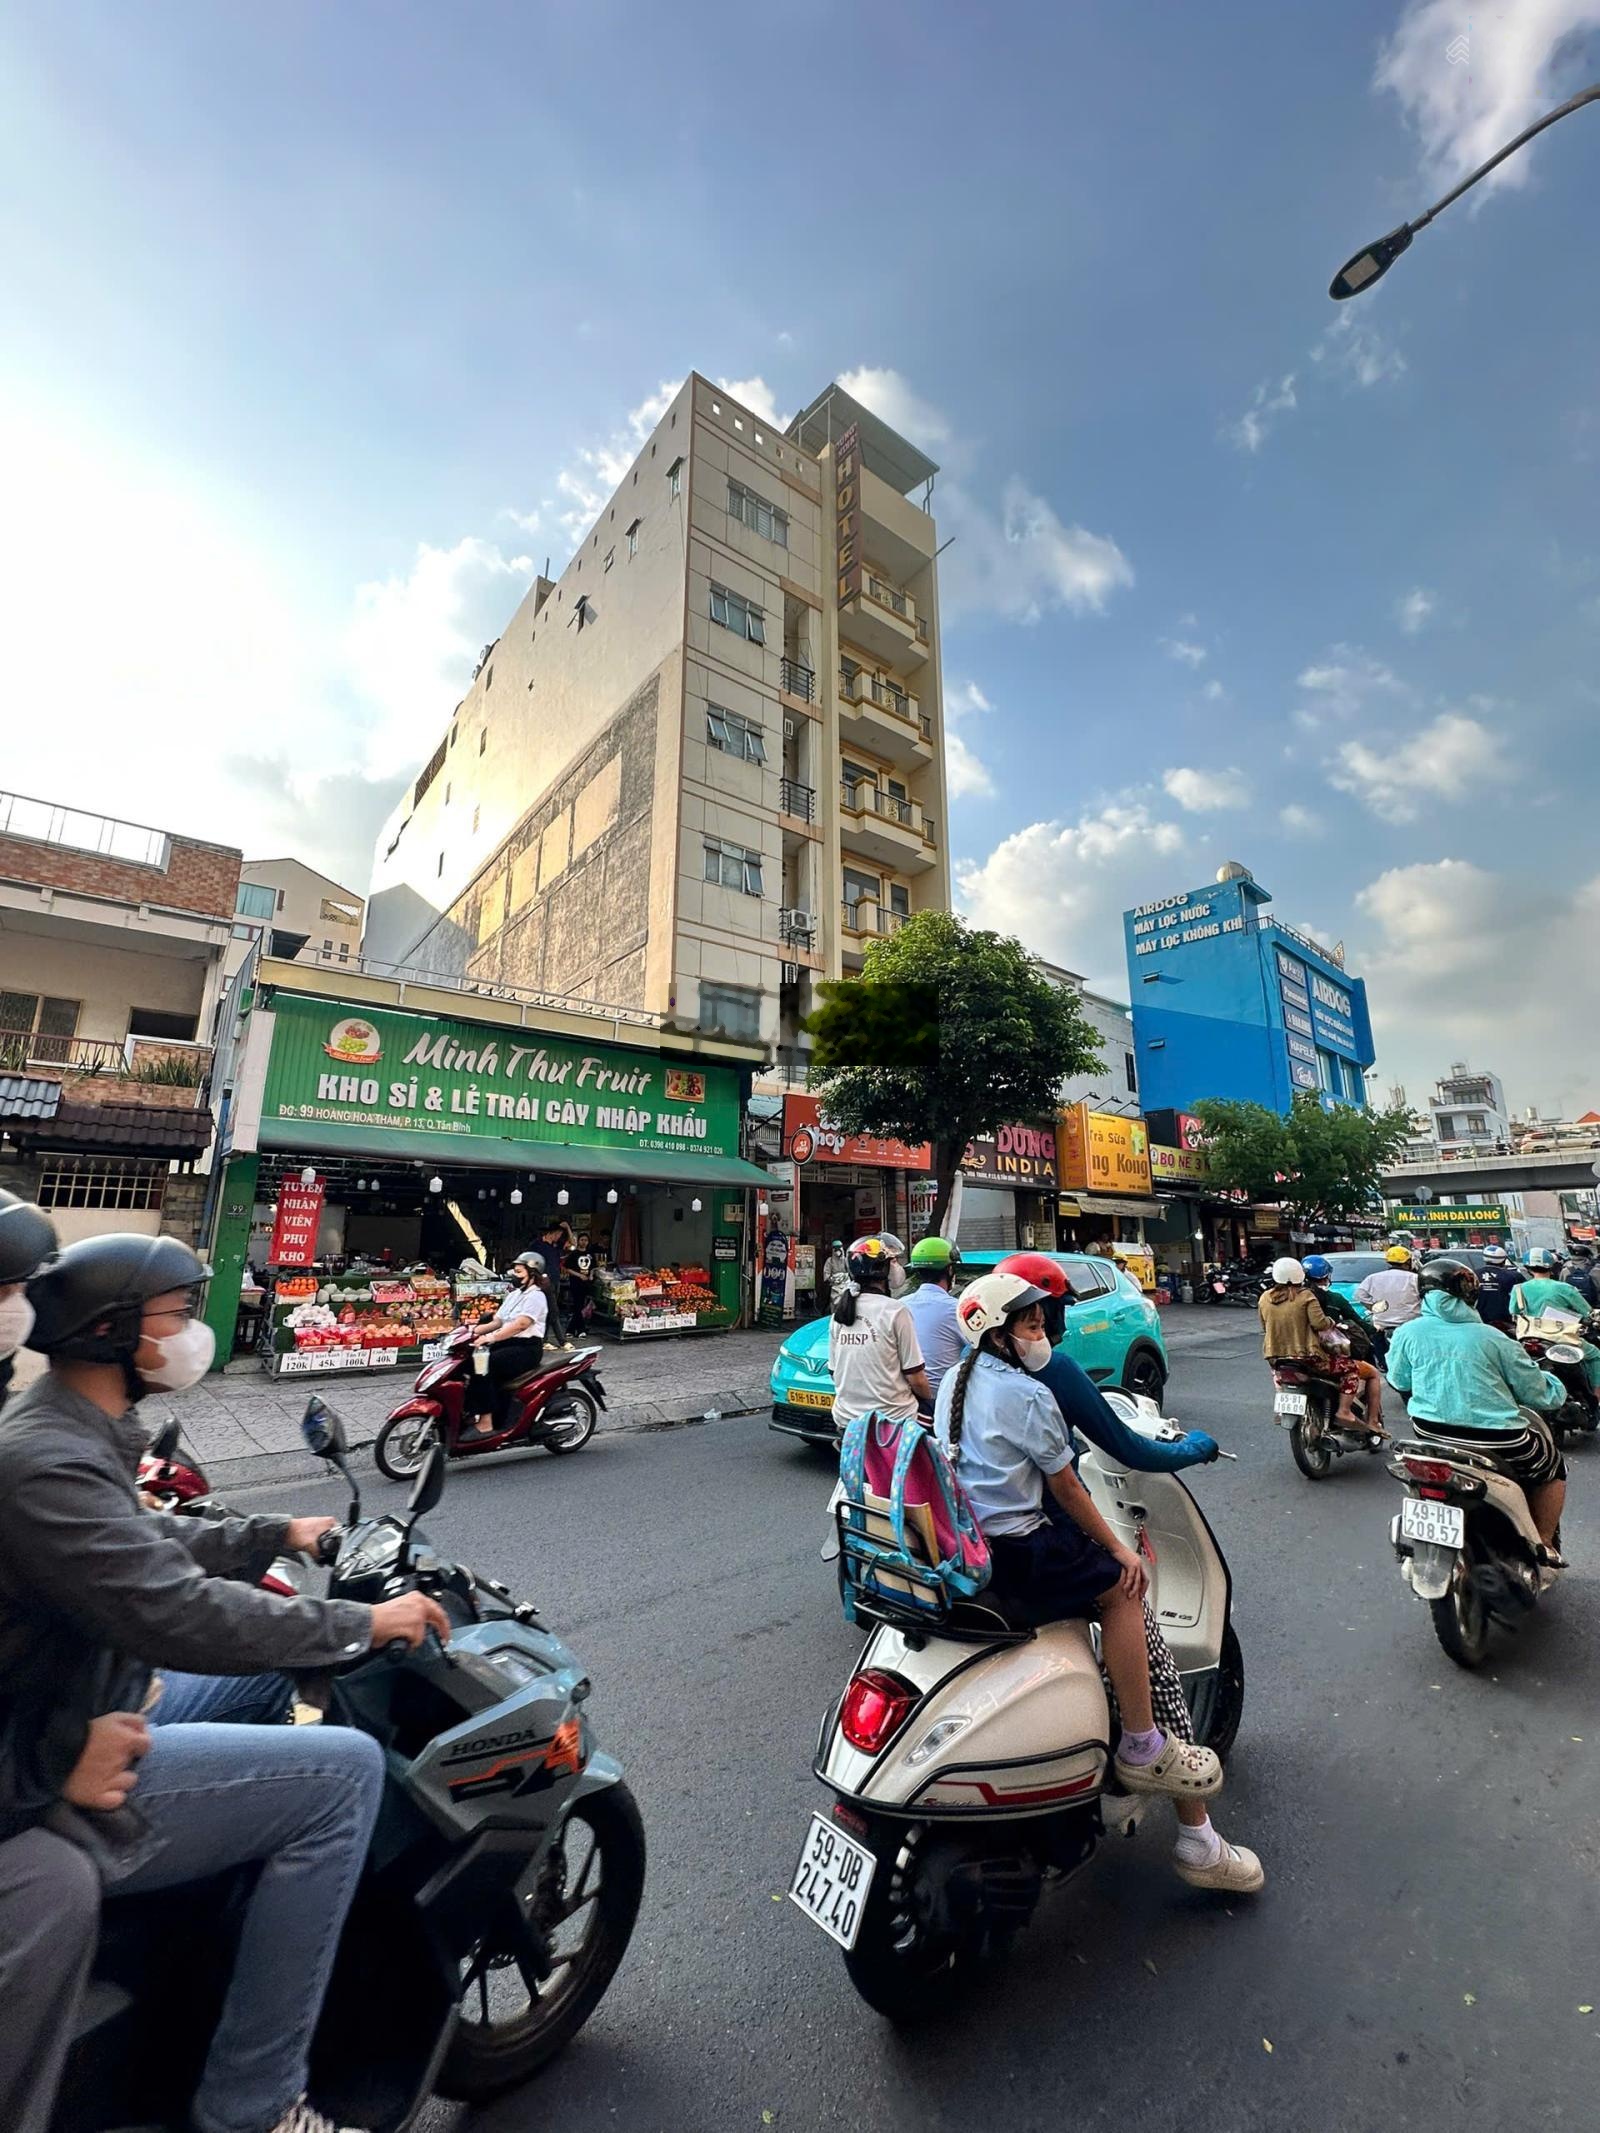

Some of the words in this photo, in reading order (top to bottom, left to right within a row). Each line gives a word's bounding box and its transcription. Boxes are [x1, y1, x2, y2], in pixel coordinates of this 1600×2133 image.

[837, 453, 855, 600] HOTEL
[1134, 894, 1188, 918] AIRDOG
[1134, 919, 1155, 935] MÁY
[1158, 912, 1177, 929] LỌC
[1180, 904, 1210, 922] NƯỚC
[1136, 939, 1157, 955] MÁY
[1160, 933, 1180, 949] LỌC
[1182, 921, 1219, 942] KHÔNG
[1223, 914, 1242, 932] KHÍ
[1312, 976, 1351, 1018] AIRDOG
[402, 1032, 498, 1076] Minh
[505, 1044, 573, 1085] Thư
[576, 1057, 652, 1096] Fruit
[299, 1104, 314, 1118] 99
[317, 1073, 380, 1105] KHO
[388, 1076, 418, 1109] SỈ
[424, 1086, 444, 1112] &
[451, 1084, 481, 1115] LẺ
[485, 1093, 539, 1121] TRÁI
[545, 1098, 590, 1126] CÂY
[596, 1106, 651, 1136] NHẬP
[656, 1107, 707, 1139] KHẨU
[997, 1155, 1055, 1176] INDIA
[1092, 1154, 1109, 1176] ng
[1116, 1152, 1148, 1180] Kong
[232, 1205, 244, 1213] 99
[283, 1197, 318, 1211] NHÂN
[1470, 1210, 1500, 1220] LONG
[284, 1214, 313, 1227] VIÊN
[282, 1233, 308, 1247] PHỤ
[279, 1251, 306, 1263] KHO
[286, 1361, 307, 1371] 120k
[318, 1359, 335, 1368] 45k
[345, 1358, 365, 1366] 100k
[376, 1355, 391, 1363] 40k
[1412, 1502, 1452, 1525] 49-H1
[1405, 1519, 1460, 1544] 208.57
[452, 1729, 535, 1756] HONDA
[812, 1826, 863, 1890] 59-DB
[795, 1862, 857, 1938] 247.40
